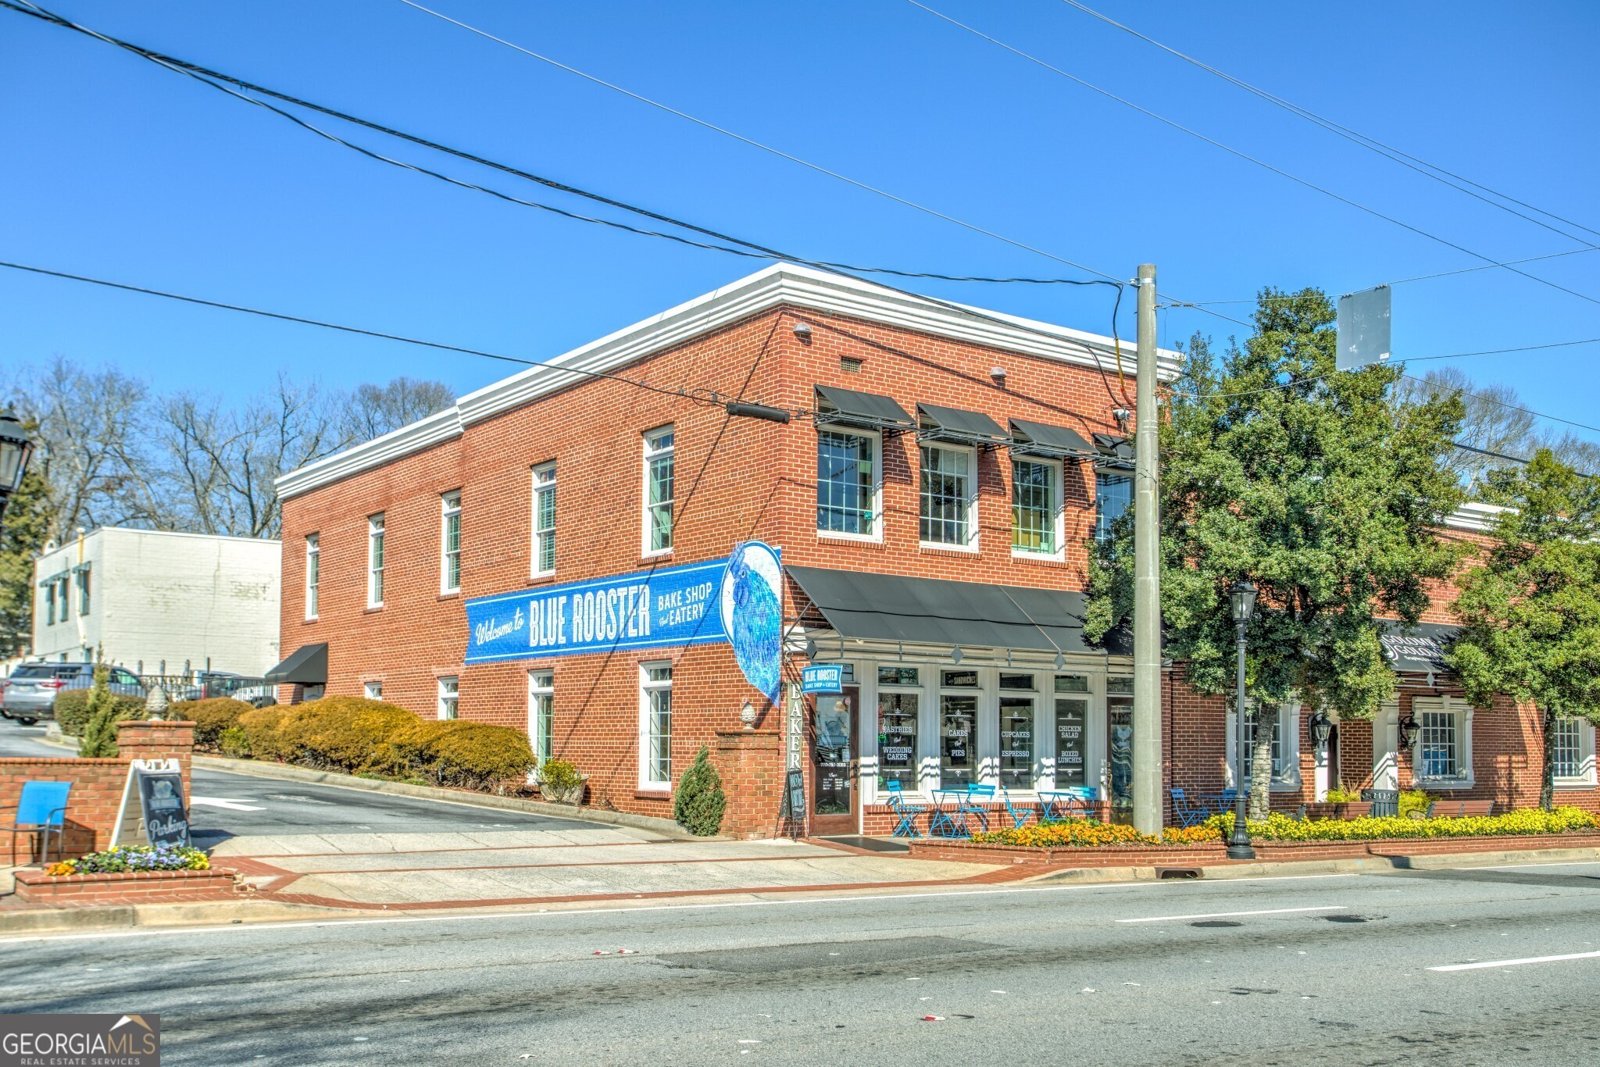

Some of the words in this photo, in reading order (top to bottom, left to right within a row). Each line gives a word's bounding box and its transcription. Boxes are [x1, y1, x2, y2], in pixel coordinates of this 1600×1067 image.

[658, 590, 683, 612] BAKE
[685, 582, 712, 604] SHOP
[476, 618, 513, 646] Welcome
[514, 607, 525, 630] to
[529, 595, 567, 647] BLUE
[572, 584, 650, 643] ROOSTER
[669, 602, 704, 626] EATERY
[805, 670, 816, 682] BLUE
[817, 669, 838, 681] ROOSTER
[790, 683, 802, 769] BAKER
[948, 729, 968, 737] CAKES
[951, 749, 965, 757] PIES
[1058, 756, 1082, 764] LUNCHES
[149, 815, 187, 840] Parking
